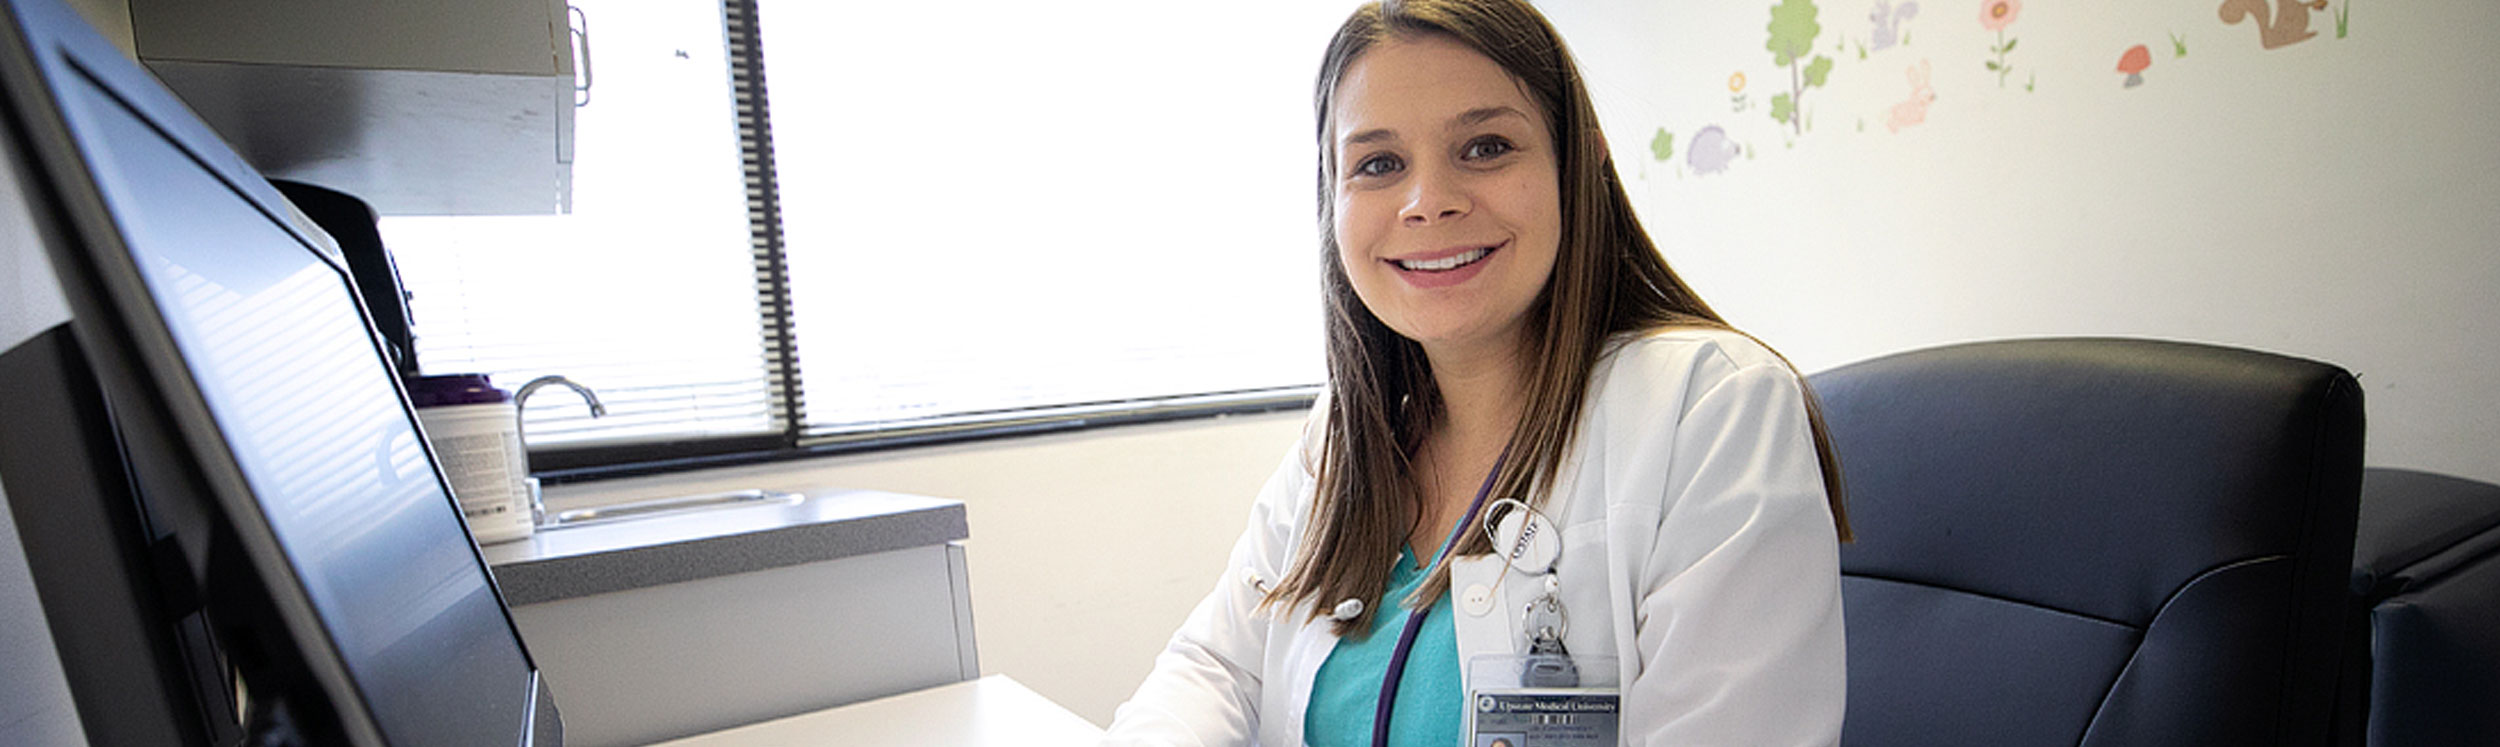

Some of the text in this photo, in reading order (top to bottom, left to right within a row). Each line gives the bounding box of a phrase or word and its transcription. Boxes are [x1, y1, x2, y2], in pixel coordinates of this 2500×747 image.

[1499, 701, 1615, 713] Upstate Medical University
